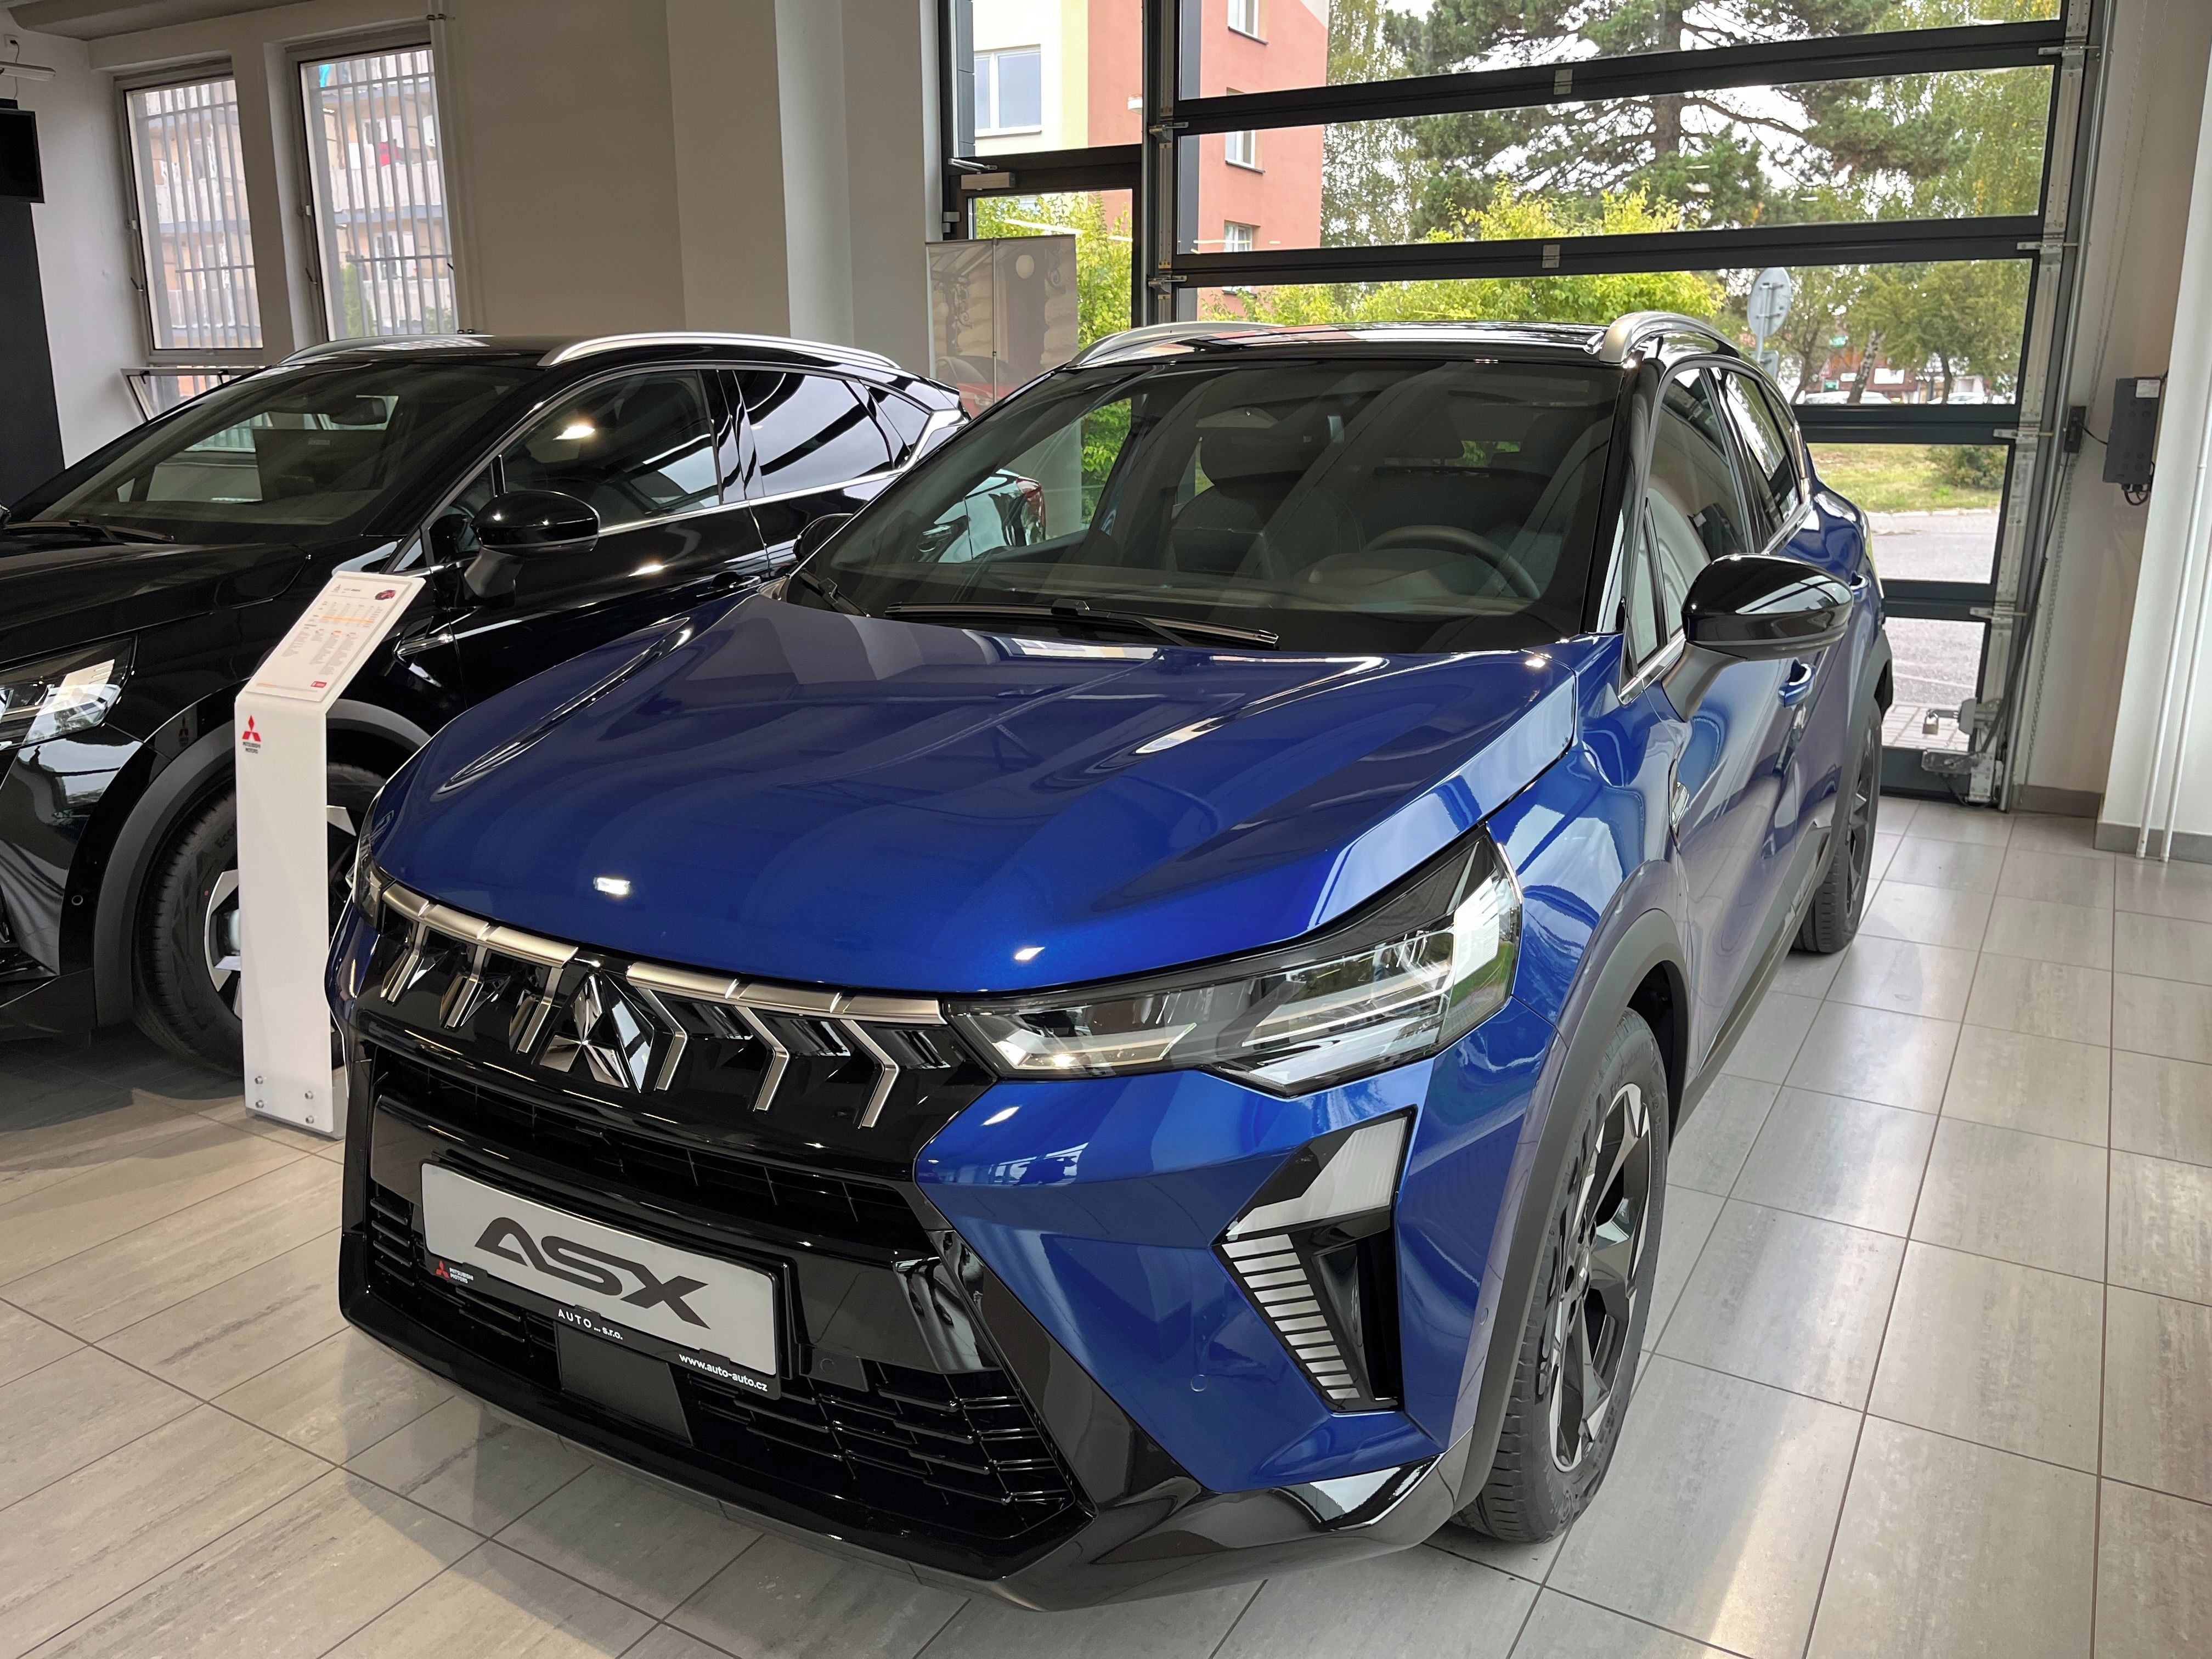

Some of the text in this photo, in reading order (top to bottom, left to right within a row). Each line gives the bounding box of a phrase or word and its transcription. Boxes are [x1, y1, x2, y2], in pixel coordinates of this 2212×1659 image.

[449, 1267, 474, 1281] MITSUBISHI
[450, 1272, 469, 1284] MOTORS
[475, 1217, 712, 1330] ASX
[558, 1308, 592, 1328] AUTO
[602, 1327, 623, 1340] s.r.o.
[679, 1353, 768, 1392] www.auto-auto.cz
